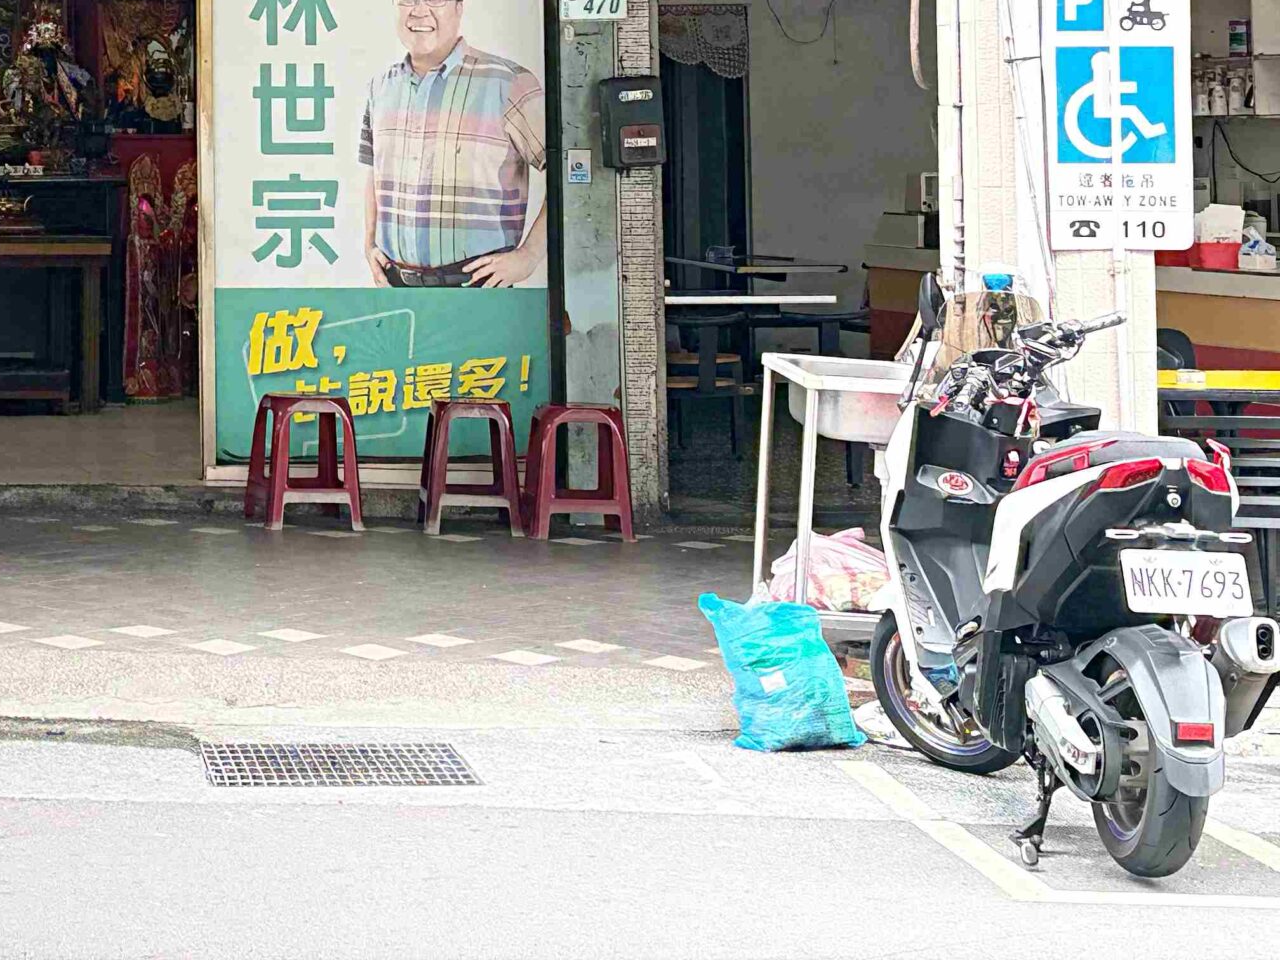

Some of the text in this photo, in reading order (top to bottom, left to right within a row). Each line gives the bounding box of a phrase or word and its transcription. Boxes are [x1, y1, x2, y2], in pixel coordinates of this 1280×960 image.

[1058, 194, 1178, 208] TOW-AWY ZONE
[1122, 220, 1166, 239] 110
